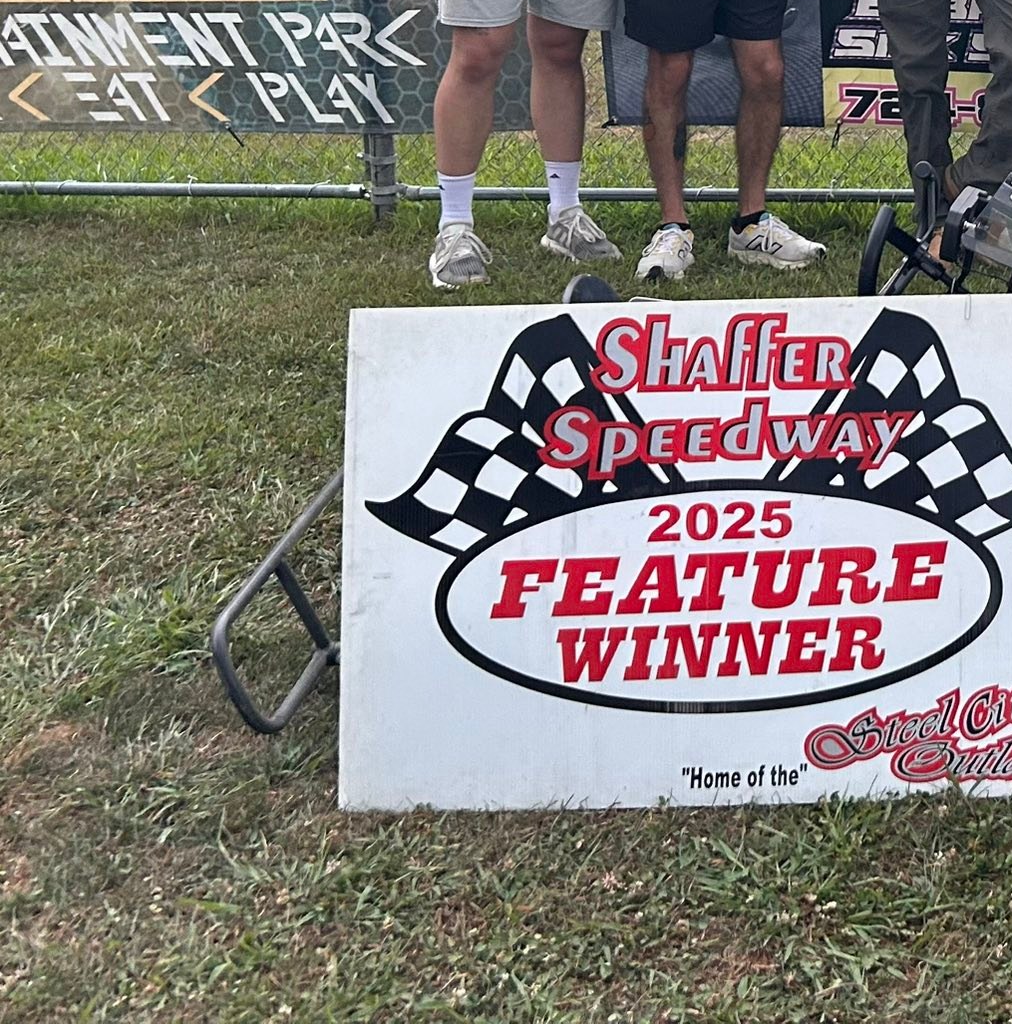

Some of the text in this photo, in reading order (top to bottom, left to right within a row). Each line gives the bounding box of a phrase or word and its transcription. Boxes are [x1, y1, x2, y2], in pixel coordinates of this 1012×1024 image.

[0, 9, 428, 67] AINMENT PARK
[62, 71, 395, 124] EAT PLAY
[647, 500, 793, 543] 2025
[490, 540, 949, 620] FEATURE
[555, 615, 886, 684] WINNER
[803, 687, 960, 770] Steel
[681, 762, 808, 789] "Home of the"
